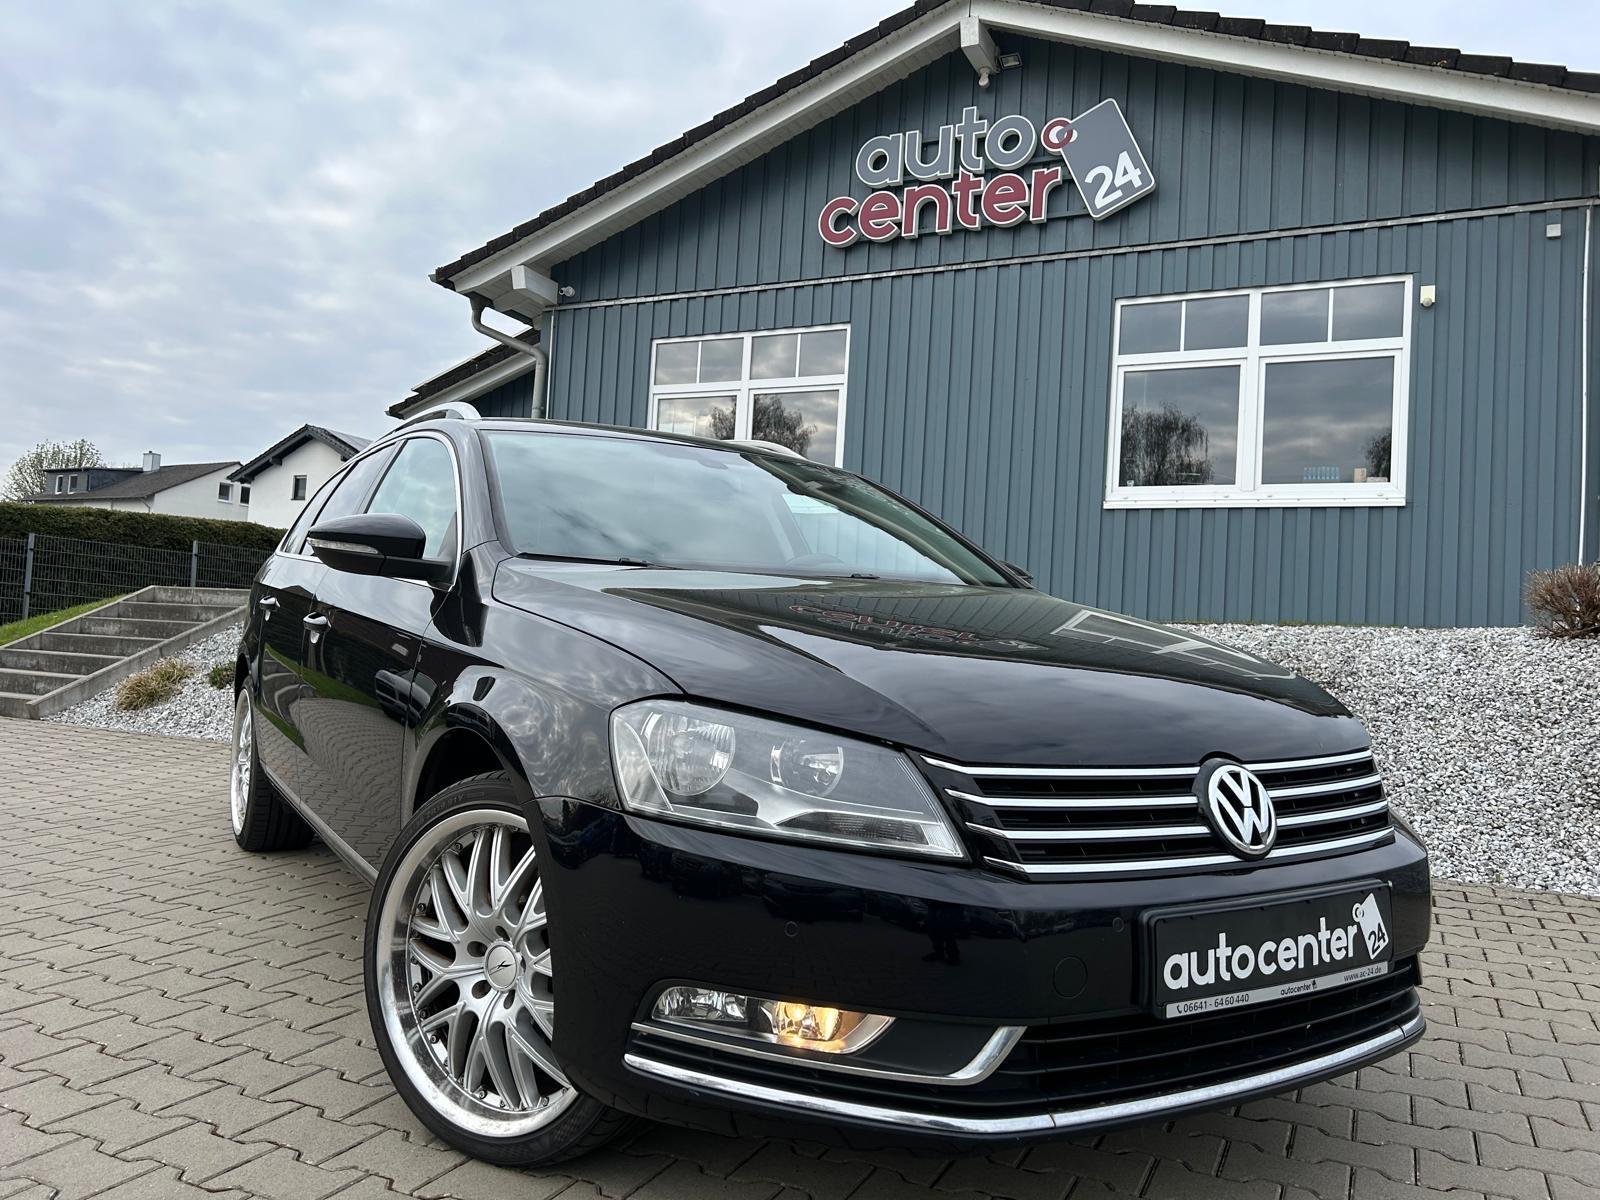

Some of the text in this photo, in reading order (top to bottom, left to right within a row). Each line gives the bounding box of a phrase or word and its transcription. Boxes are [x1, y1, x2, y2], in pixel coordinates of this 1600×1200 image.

[856, 106, 1037, 186] auto
[1084, 150, 1142, 209] 24
[818, 166, 1062, 247] center
[1367, 922, 1387, 952] 24
[1343, 965, 1382, 982] www.ac-24.de
[1280, 982, 1312, 996] autocenter
[1183, 1000, 1207, 1013] 06641
